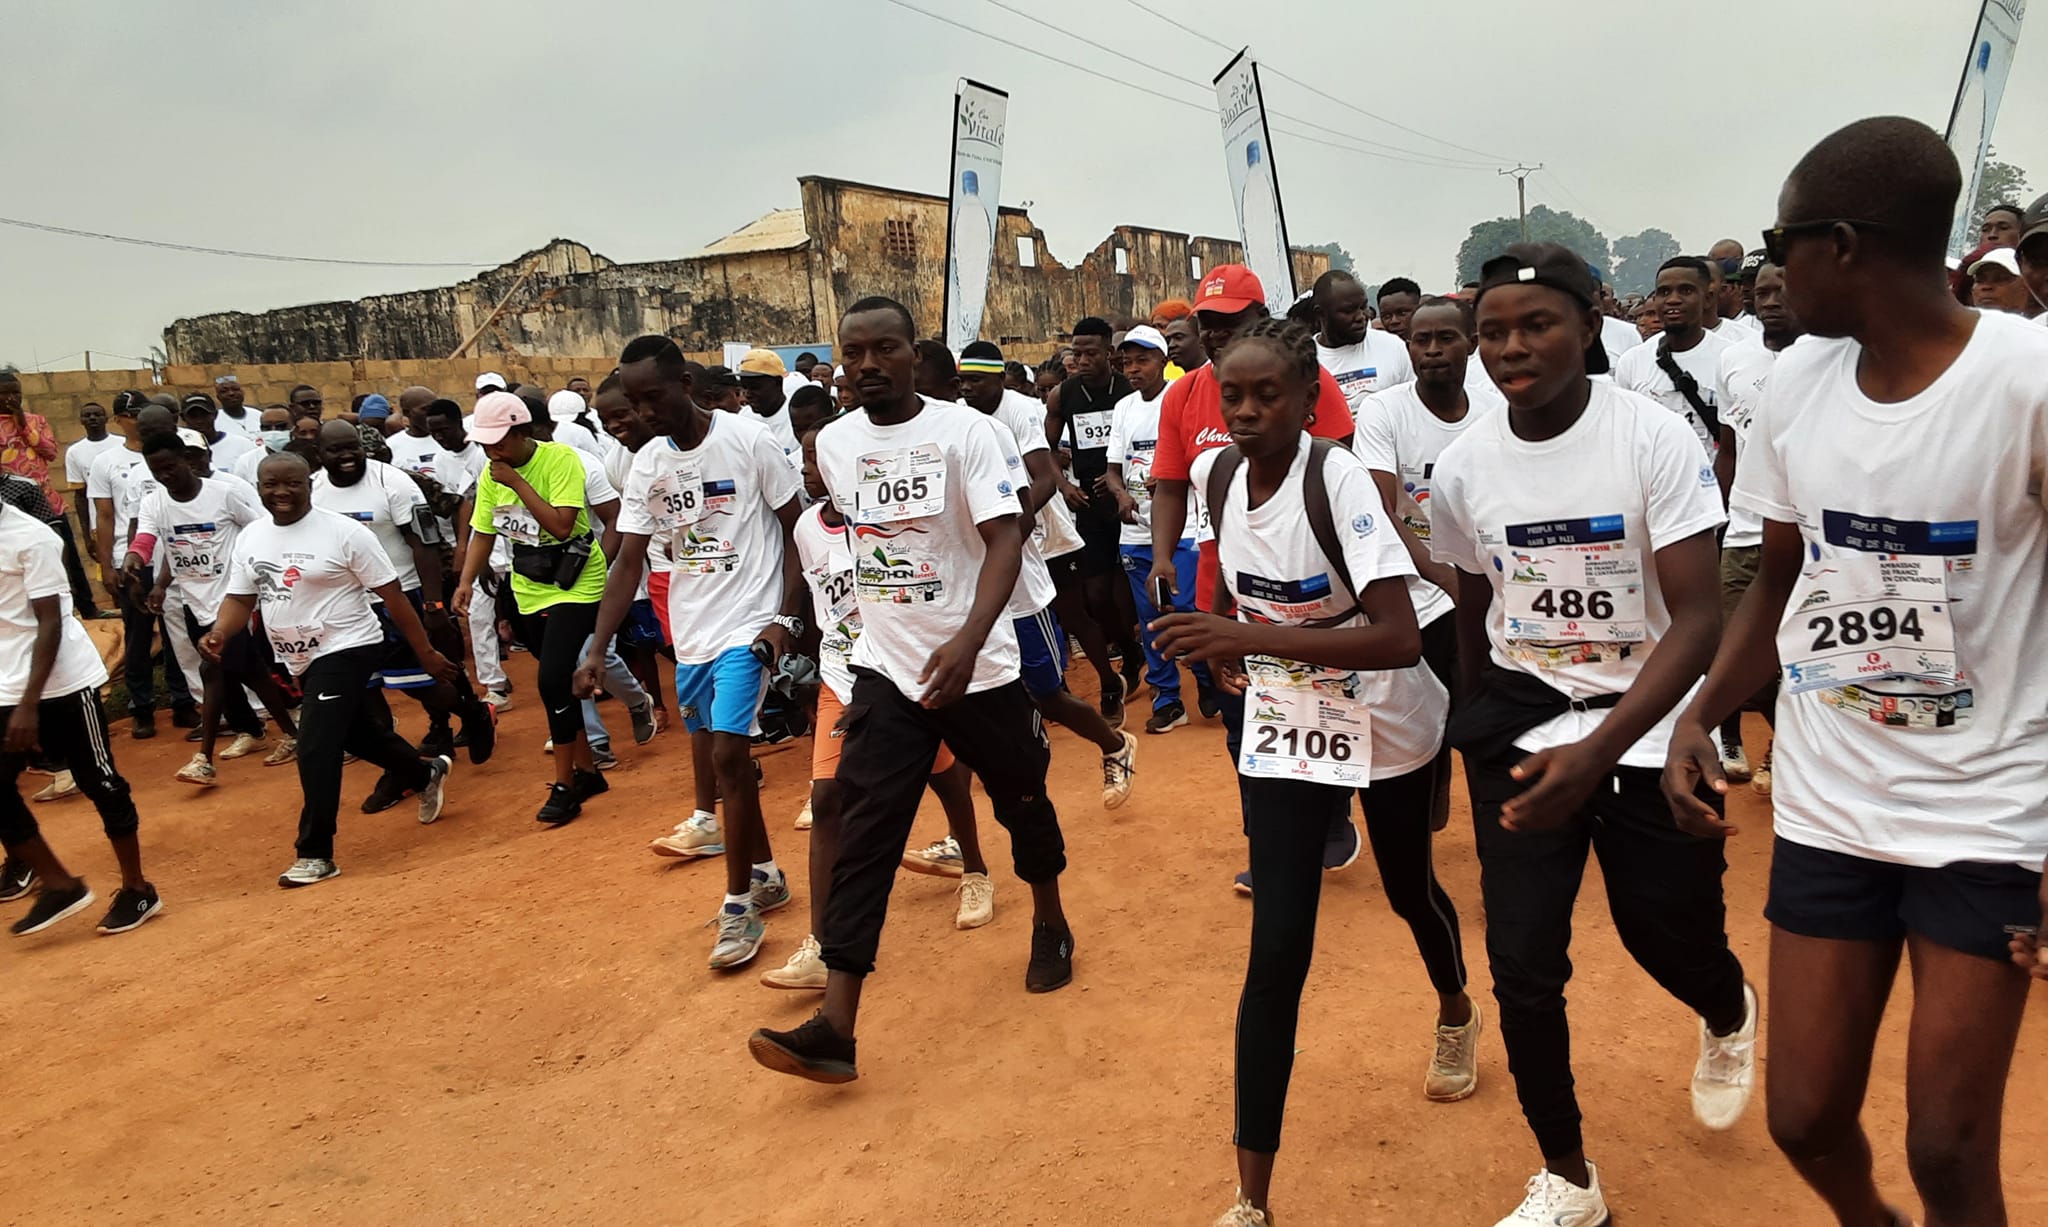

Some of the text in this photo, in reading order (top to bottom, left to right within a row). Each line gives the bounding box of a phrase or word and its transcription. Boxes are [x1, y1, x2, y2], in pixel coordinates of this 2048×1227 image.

[1084, 424, 1112, 439] 932
[877, 476, 928, 505] 065
[662, 490, 695, 514] 358
[502, 515, 528, 535] 204
[174, 554, 210, 567] 2640
[1531, 588, 1614, 620] 486
[1808, 606, 1924, 651] 2894
[274, 637, 320, 653] 3024
[1857, 661, 1892, 673] telecel
[1255, 725, 1351, 761] 2106
